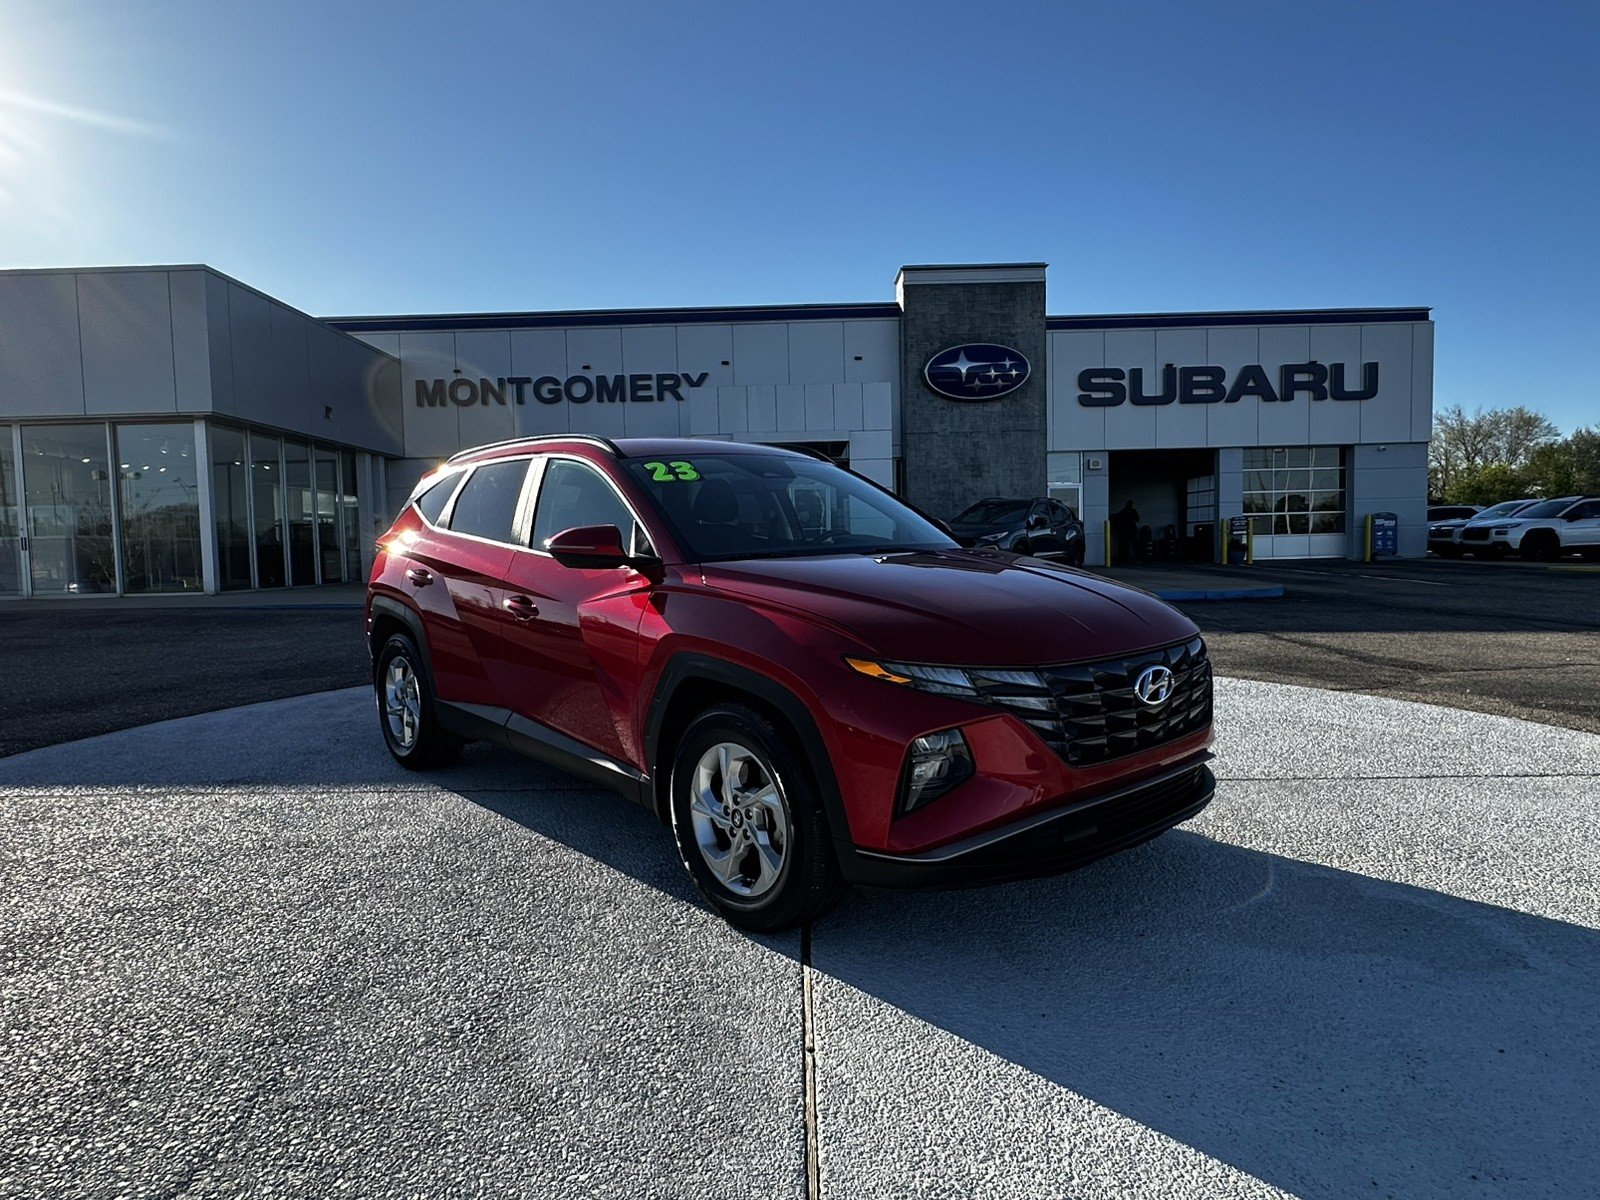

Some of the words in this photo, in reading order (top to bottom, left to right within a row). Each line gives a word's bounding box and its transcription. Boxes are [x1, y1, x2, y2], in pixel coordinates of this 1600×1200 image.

[414, 372, 709, 408] MONTGOMERY
[1077, 361, 1379, 407] SUBARU
[643, 461, 700, 481] 23
